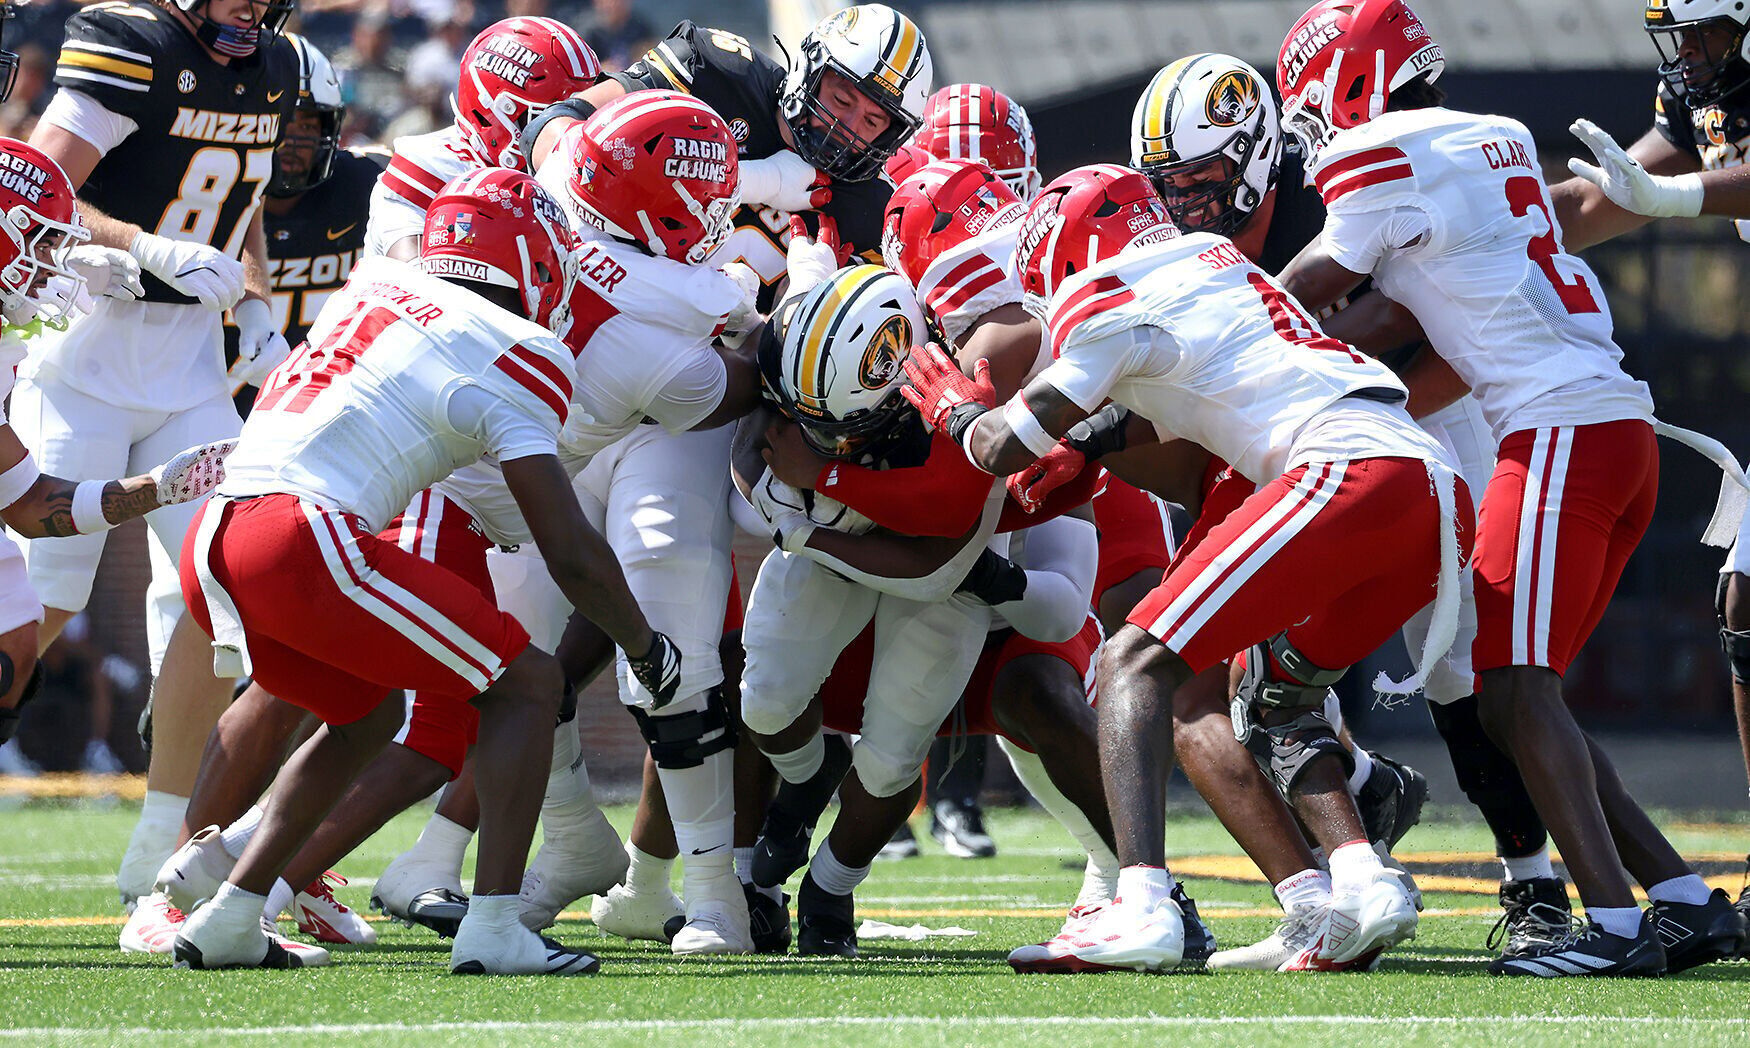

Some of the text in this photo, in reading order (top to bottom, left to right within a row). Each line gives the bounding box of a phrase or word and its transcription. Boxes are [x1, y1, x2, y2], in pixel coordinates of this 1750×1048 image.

[1286, 22, 1344, 89] CAJUNS
[1411, 46, 1444, 71] LOUIS
[178, 70, 196, 92] SEC
[474, 50, 532, 90] CAJUNS
[873, 74, 901, 97] MIZZOU
[169, 107, 281, 144] MIZZOU
[729, 119, 748, 141] SEC
[1704, 108, 1728, 146] C
[1481, 140, 1533, 170] CLARK
[664, 157, 728, 184] CAJUNS
[154, 146, 274, 262] 87
[1133, 203, 1142, 214] 4
[965, 207, 992, 236] SBC
[1127, 212, 1155, 233] SBC
[1505, 176, 1601, 314] 2
[405, 303, 443, 327] JR
[796, 403, 824, 417] MIZZOU
